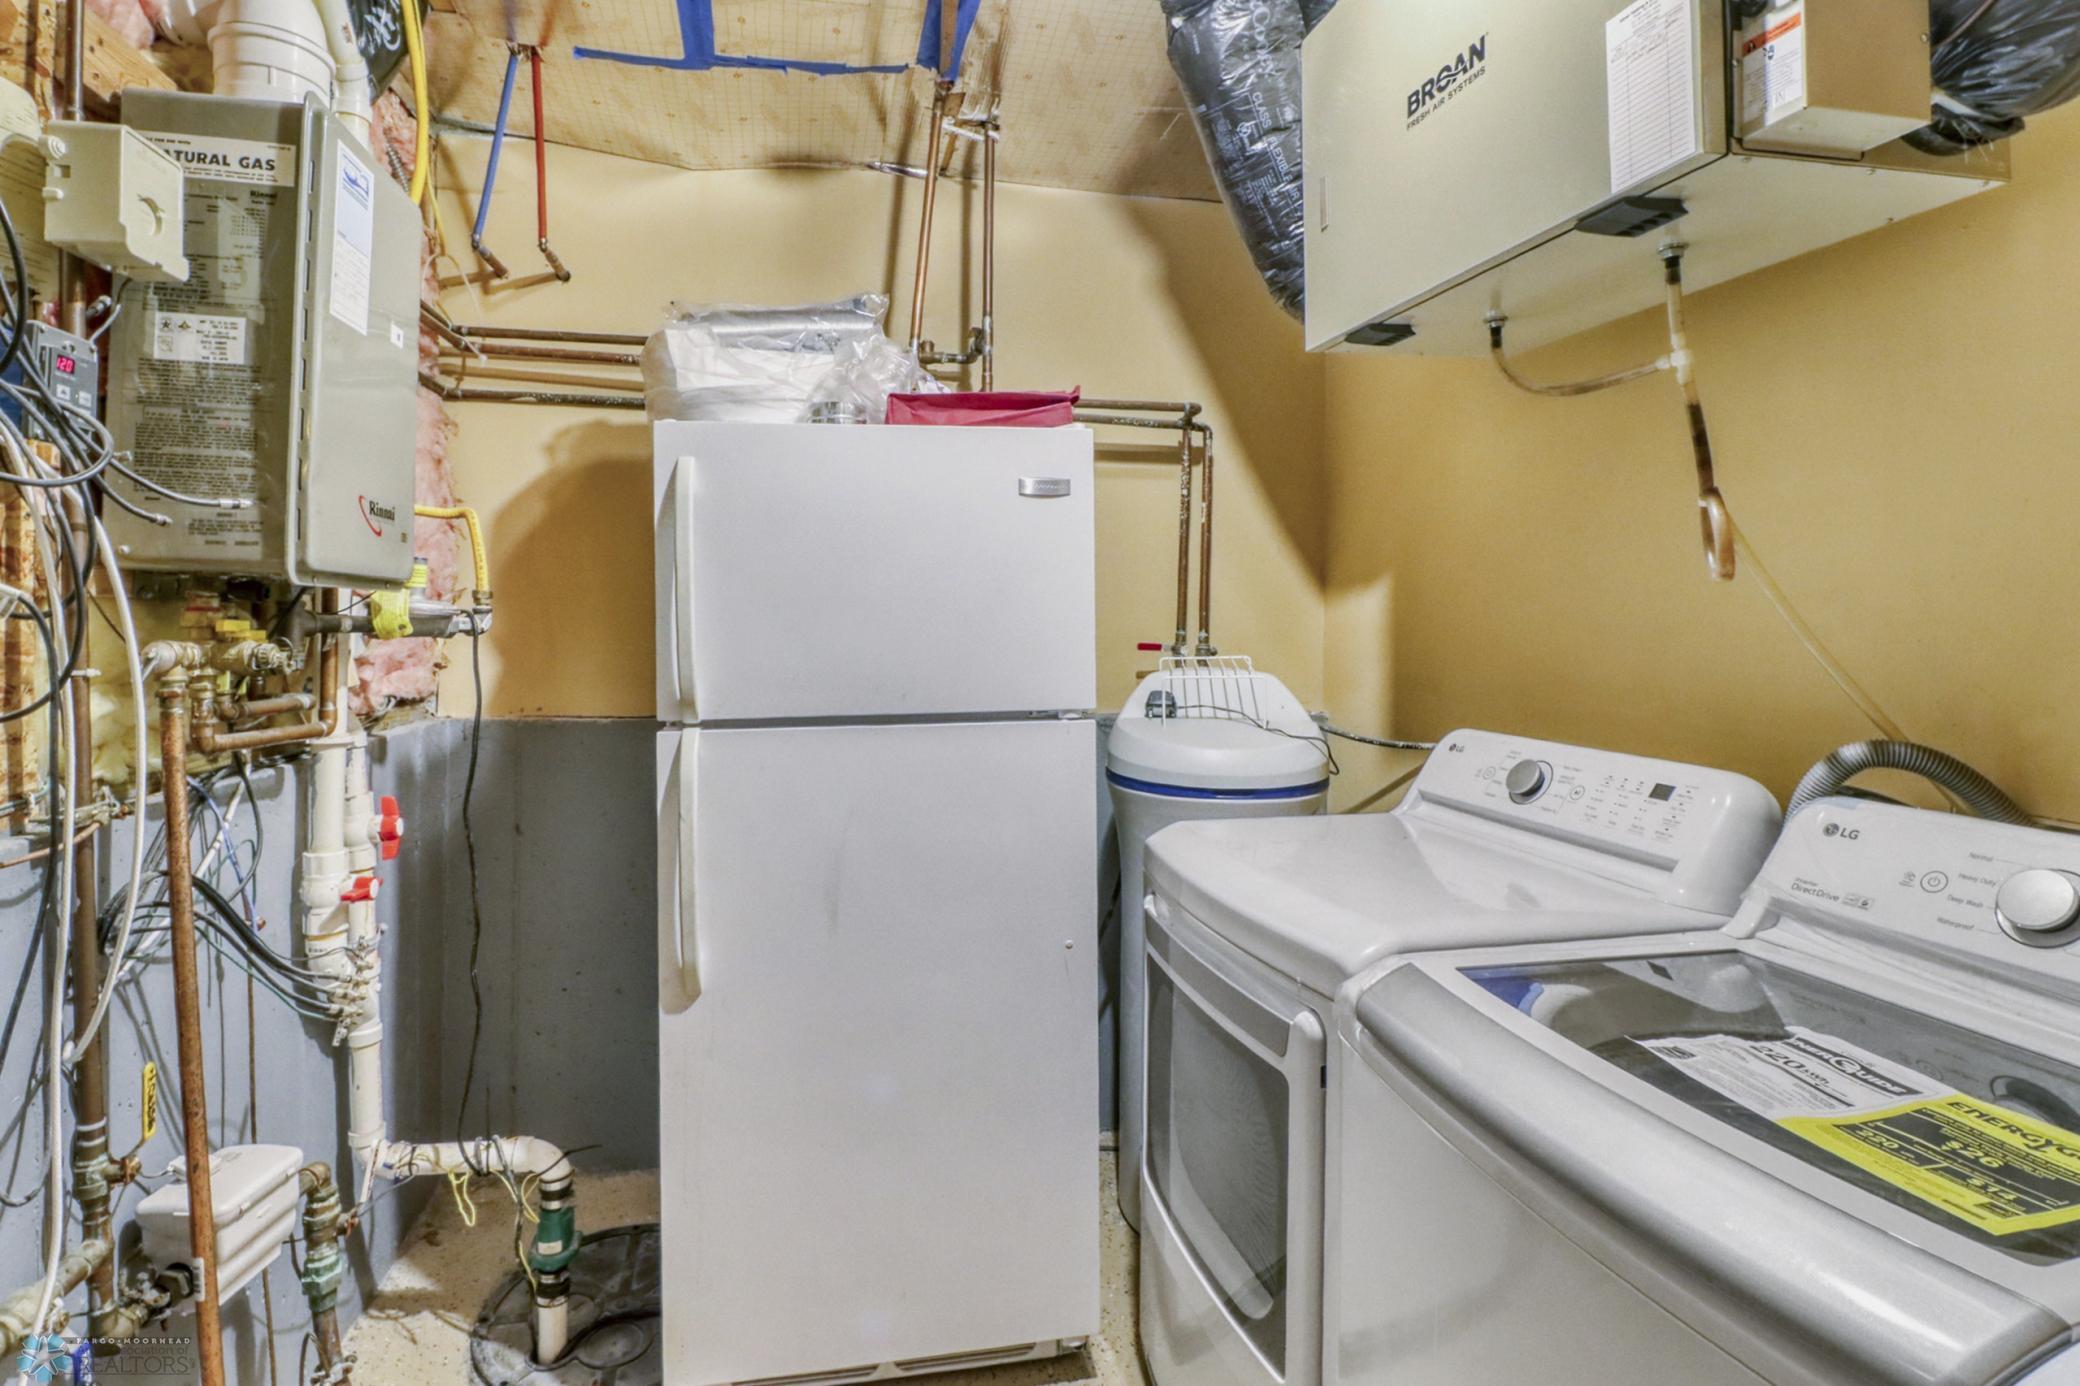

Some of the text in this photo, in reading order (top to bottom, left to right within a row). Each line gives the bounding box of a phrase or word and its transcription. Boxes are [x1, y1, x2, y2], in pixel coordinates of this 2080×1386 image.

[1407, 34, 1486, 119] BROAN
[1252, 91, 1272, 128] CLASS
[1406, 65, 1486, 131] FRESH AIR SYSTEMS
[164, 149, 276, 171] TURAL GAS
[56, 356, 74, 373] 120
[1840, 827, 1860, 840] LG
